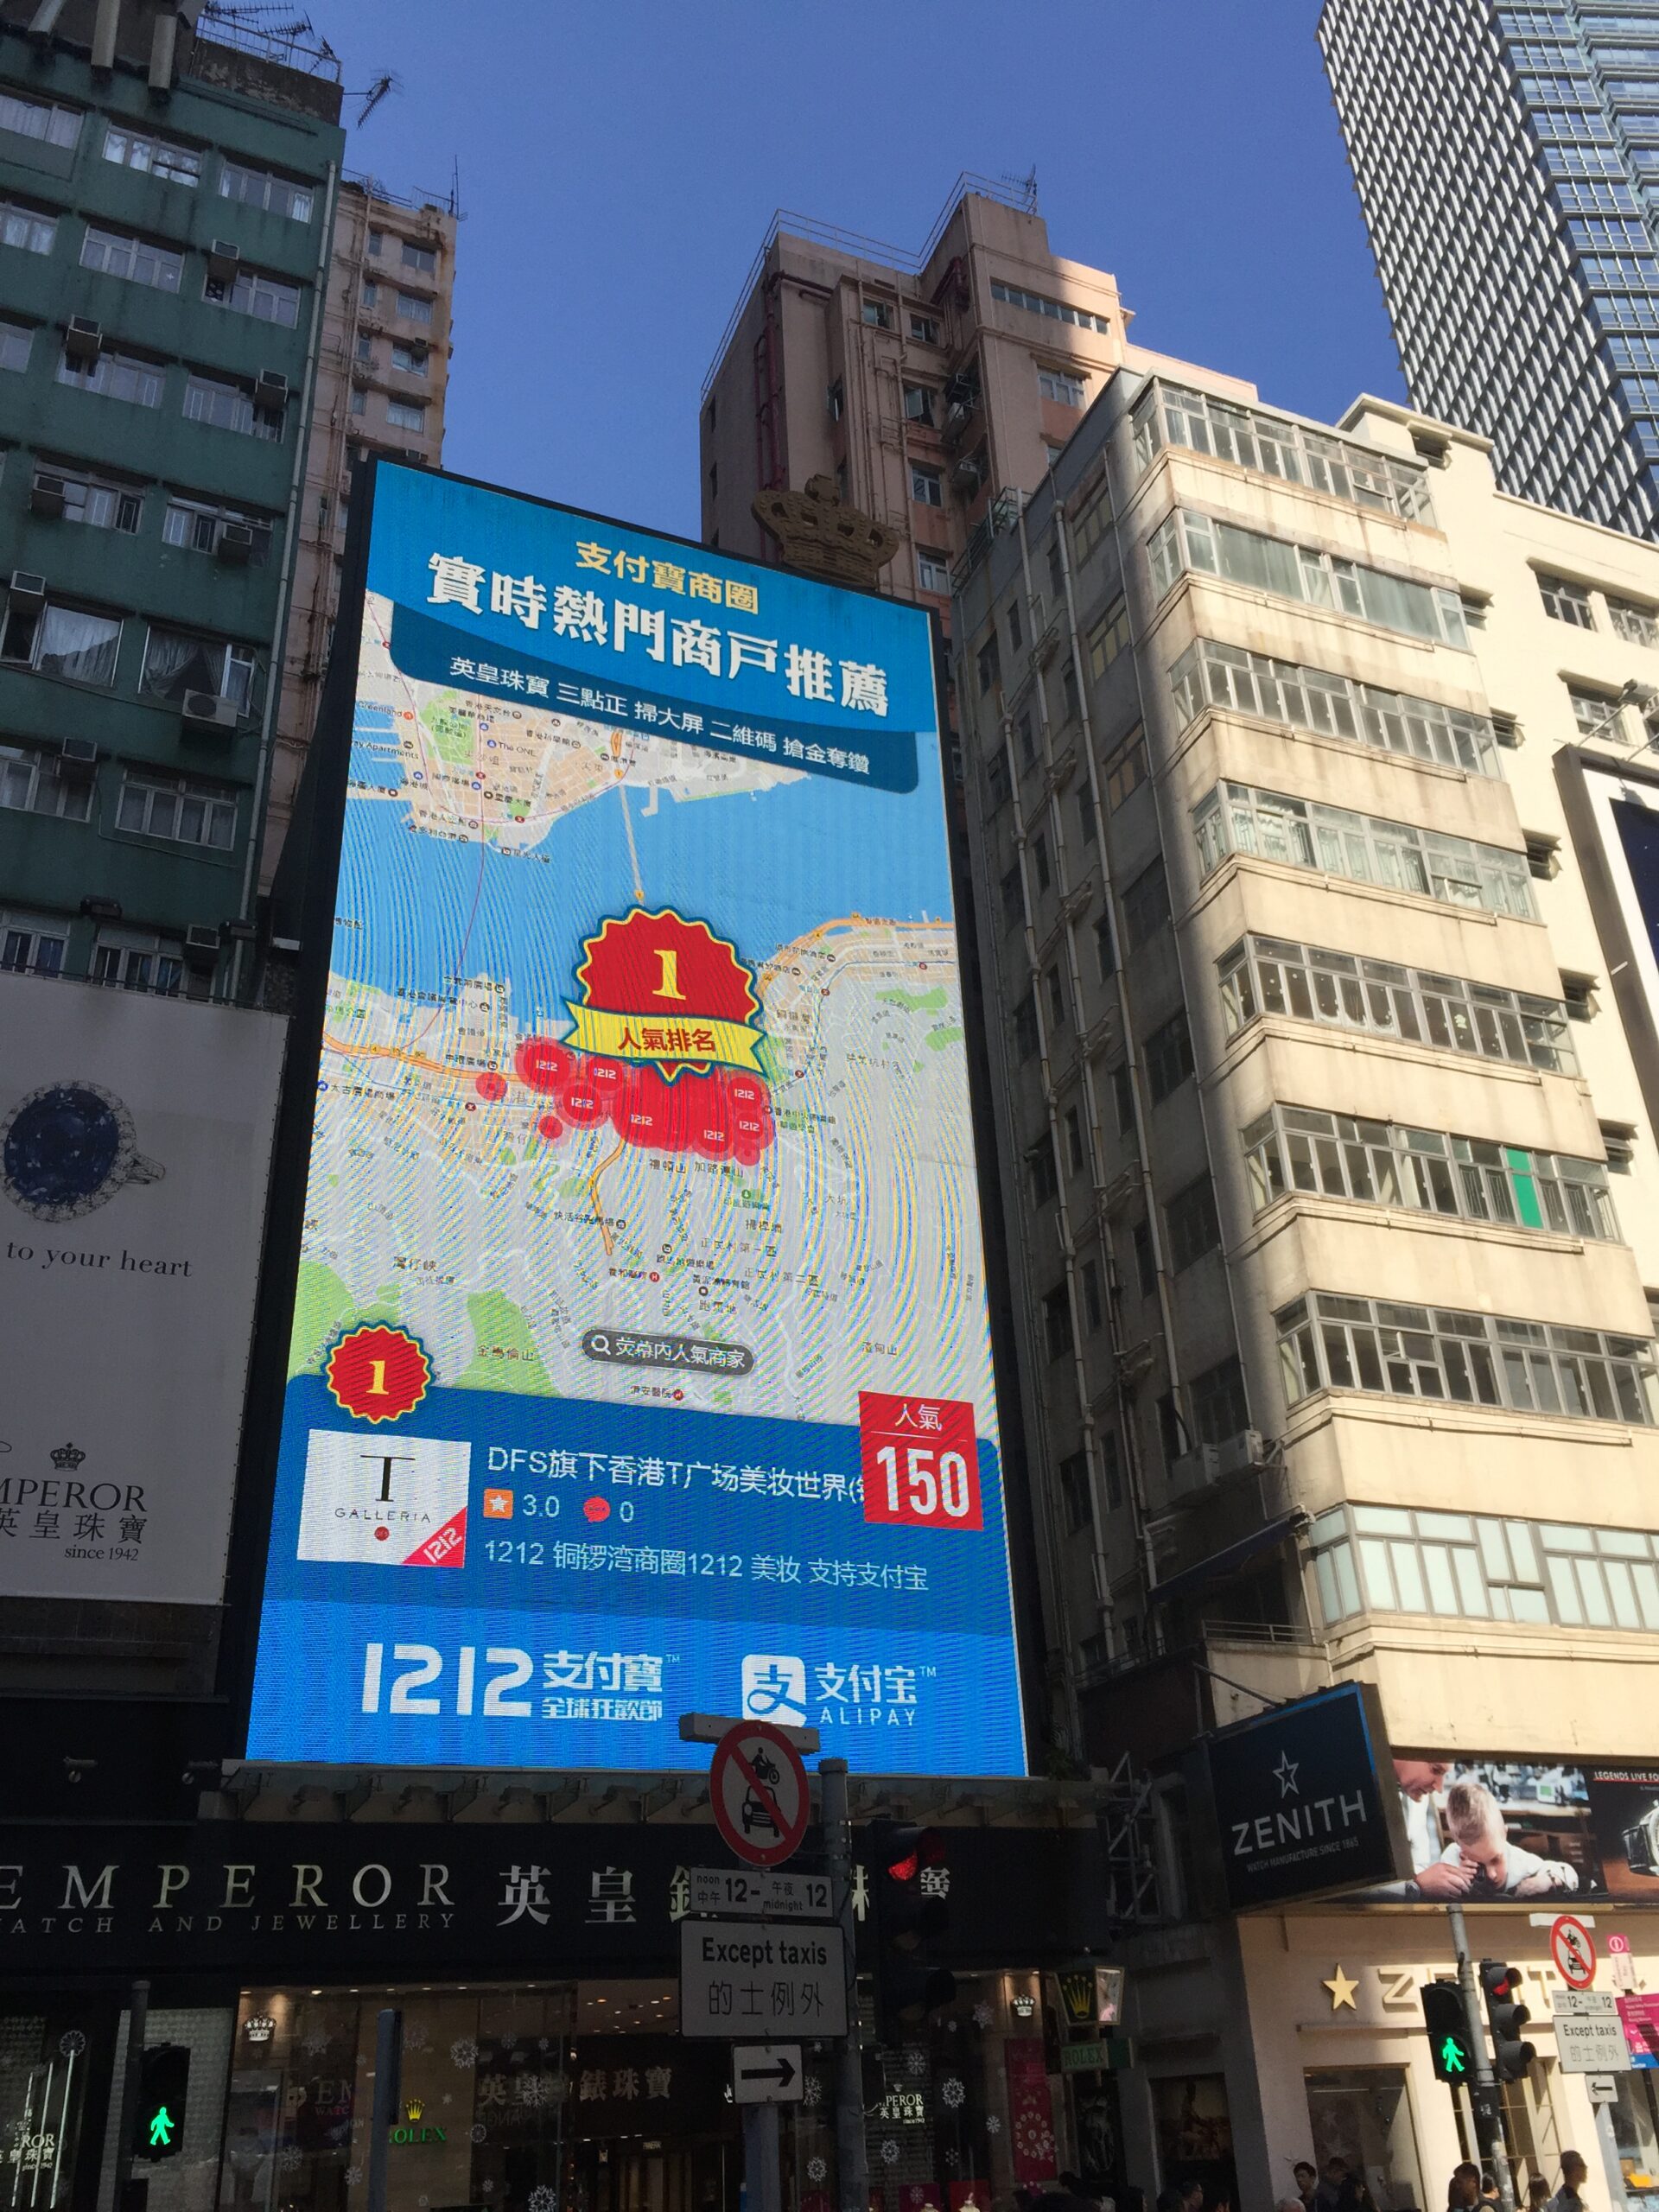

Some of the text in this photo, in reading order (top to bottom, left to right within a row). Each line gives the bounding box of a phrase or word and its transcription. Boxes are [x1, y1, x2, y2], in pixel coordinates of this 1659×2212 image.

[575, 541, 759, 614] 支付寶商圈
[449, 657, 549, 699] 英皇珠寶
[556, 681, 628, 717] 三點正
[634, 698, 703, 735] 掃大屏
[710, 720, 776, 753] 二維碼
[366, 741, 419, 760] Apartments
[652, 950, 686, 1001] 1
[618, 1027, 715, 1052] 人氣排名
[536, 1060, 558, 1071] 1212
[594, 1067, 616, 1080] 1212
[734, 1087, 755, 1100] 1212
[631, 1114, 653, 1127] 1212
[739, 1121, 760, 1133] 1212
[703, 1128, 725, 1141] 1212
[6, 1242, 194, 1278] to your heart
[366, 1360, 389, 1395] 1
[895, 1403, 942, 1431] 人氣
[360, 1455, 416, 1502] T
[877, 1446, 969, 1517] 150
[335, 1508, 430, 1523] GALLERIA
[522, 1494, 634, 1522] 3.0 0
[65, 1547, 139, 1561] since 1942
[423, 1528, 462, 1563] 1212
[485, 1540, 544, 1566] 1212
[751, 1554, 801, 1584] 美妆
[808, 1558, 929, 1591] 支持支付宝
[362, 1643, 533, 1717] 1212
[543, 1649, 663, 1693] 支付寶
[815, 1662, 918, 1704] 支付宝
[820, 1707, 915, 1726] ALIPAY
[1594, 1771, 1629, 1780] LEGENDS
[1232, 1790, 1367, 1856] ZENITH
[0, 1863, 455, 1911] EMPEROR
[696, 1874, 720, 1885] noon
[772, 1881, 794, 1897] 午夜
[697, 1891, 721, 1906] 中午
[763, 1899, 804, 1912] midnight
[806, 1884, 827, 1908] 12
[149, 1915, 222, 1934] AND
[251, 1911, 455, 1933] JEWELLERY
[702, 1936, 827, 1969] Except taxis
[709, 1980, 823, 2018] 的士例外
[1602, 1995, 1612, 2009] 12
[1563, 2024, 1618, 2038] Except taxis
[1064, 2047, 1103, 2066] ROLEX
[1570, 2044, 1619, 2063] 的士例外
[389, 2126, 447, 2145] OLEX
